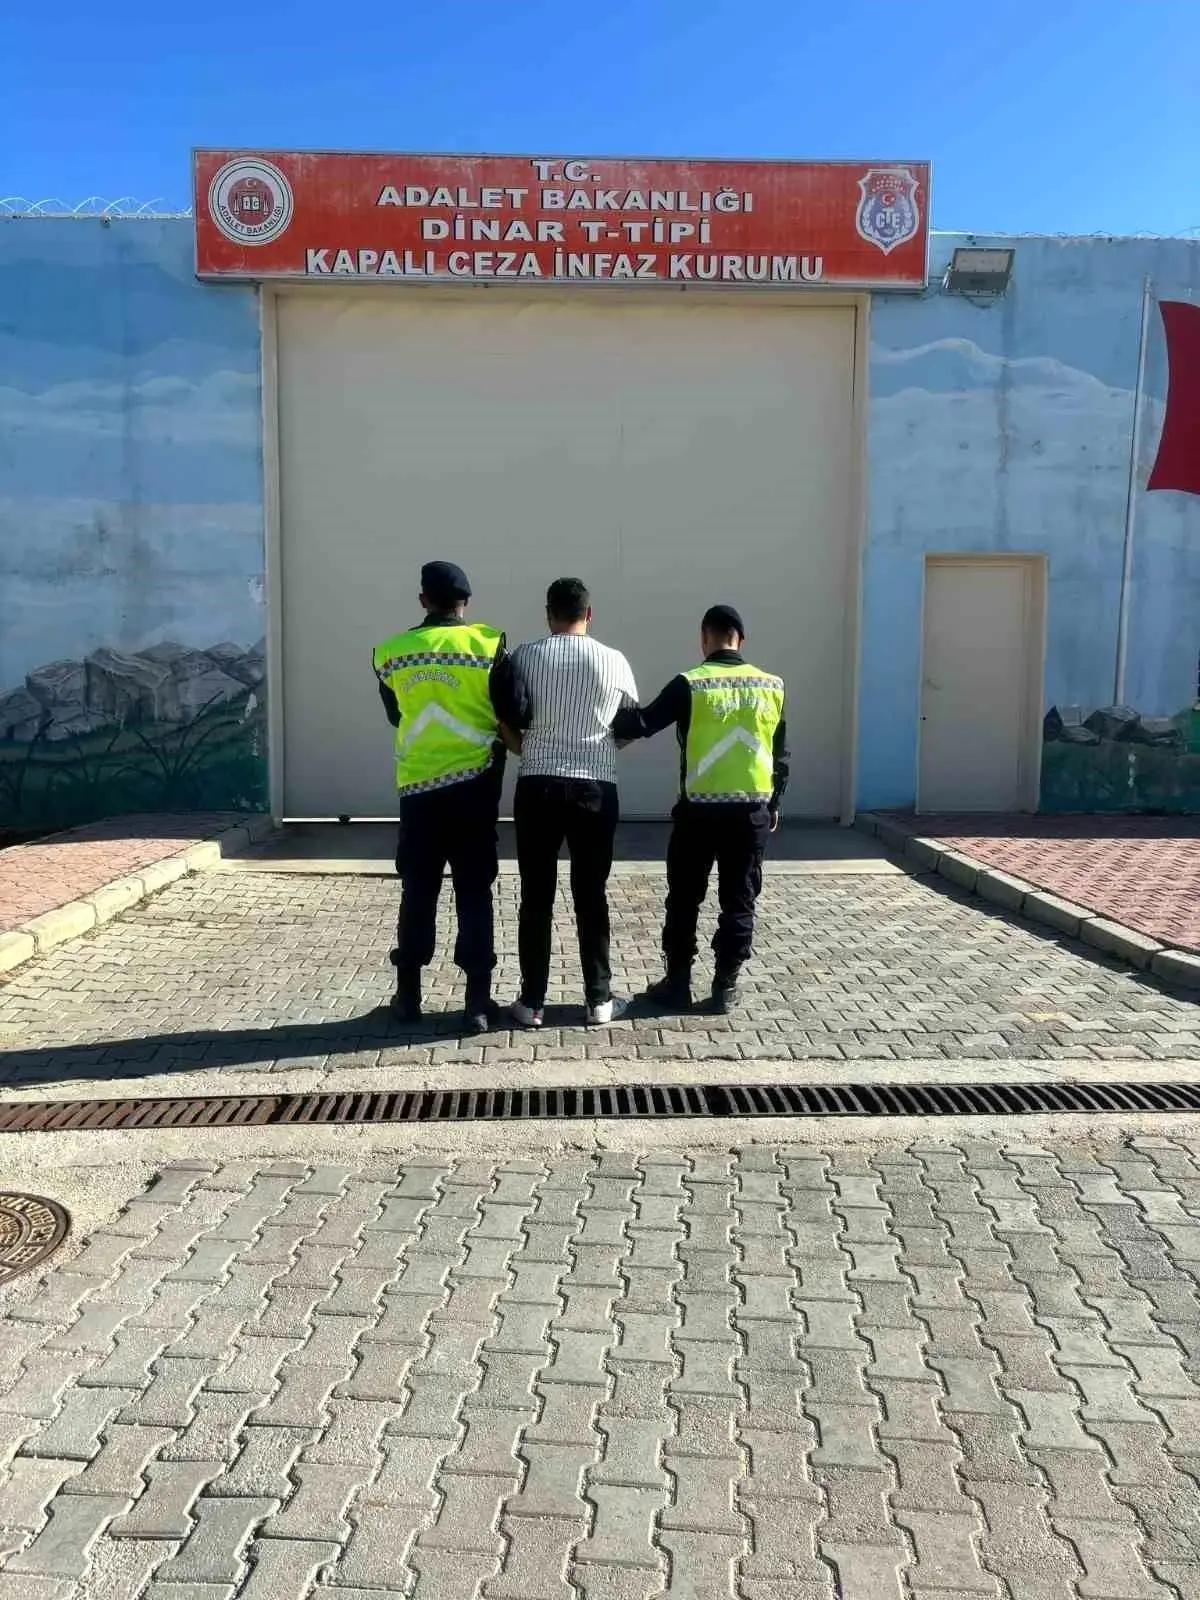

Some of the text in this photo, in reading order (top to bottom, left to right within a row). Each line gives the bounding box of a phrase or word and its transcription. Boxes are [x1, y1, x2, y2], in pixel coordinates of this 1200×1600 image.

[532, 160, 600, 183] T.C.
[377, 186, 753, 213] ADALET BAKANLIĞI
[219, 204, 245, 234] ADALET
[422, 214, 712, 244] DİNAR T-TİPİ
[876, 208, 901, 228] CTE
[306, 247, 823, 281] KAPALI CEZA İNFAZ KURUMU
